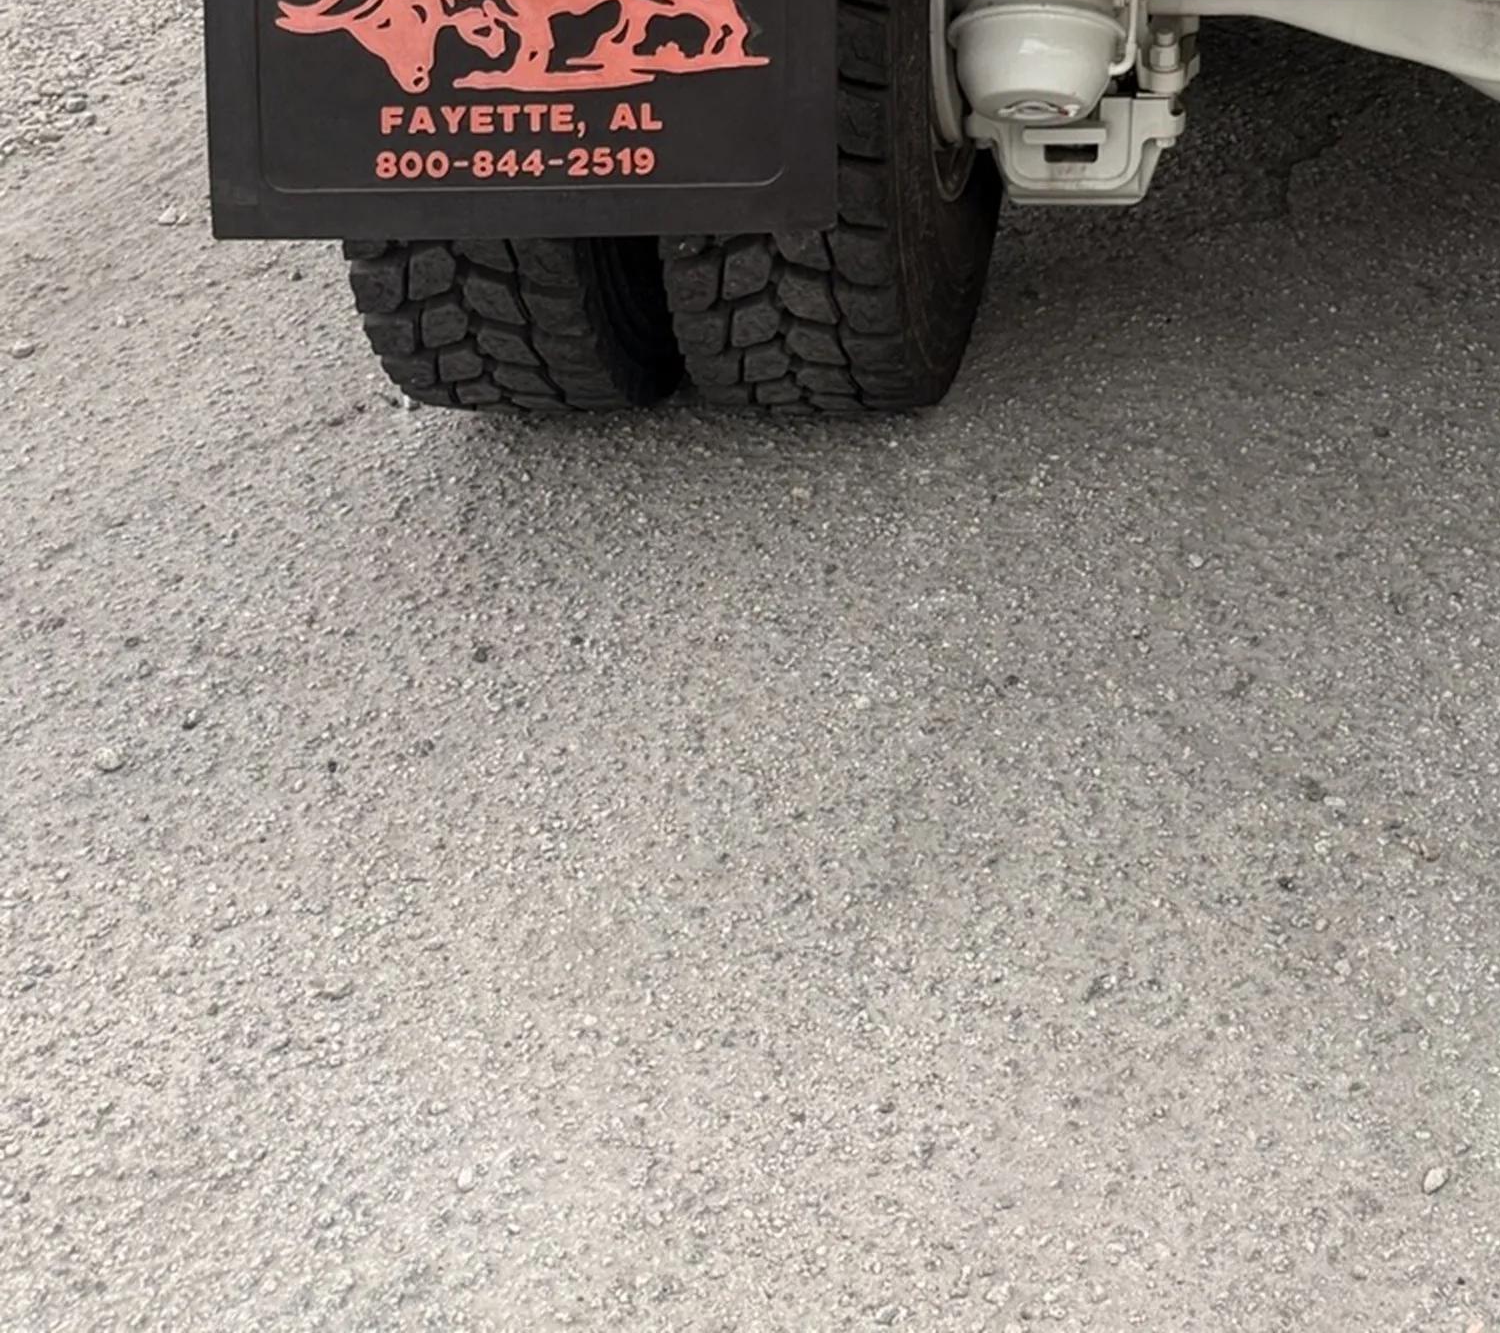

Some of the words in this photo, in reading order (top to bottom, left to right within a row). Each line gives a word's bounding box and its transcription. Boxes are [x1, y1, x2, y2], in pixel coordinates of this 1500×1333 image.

[379, 102, 588, 139] FAYETTE,
[608, 102, 664, 132] AL
[374, 146, 656, 180] 800-844-2519
